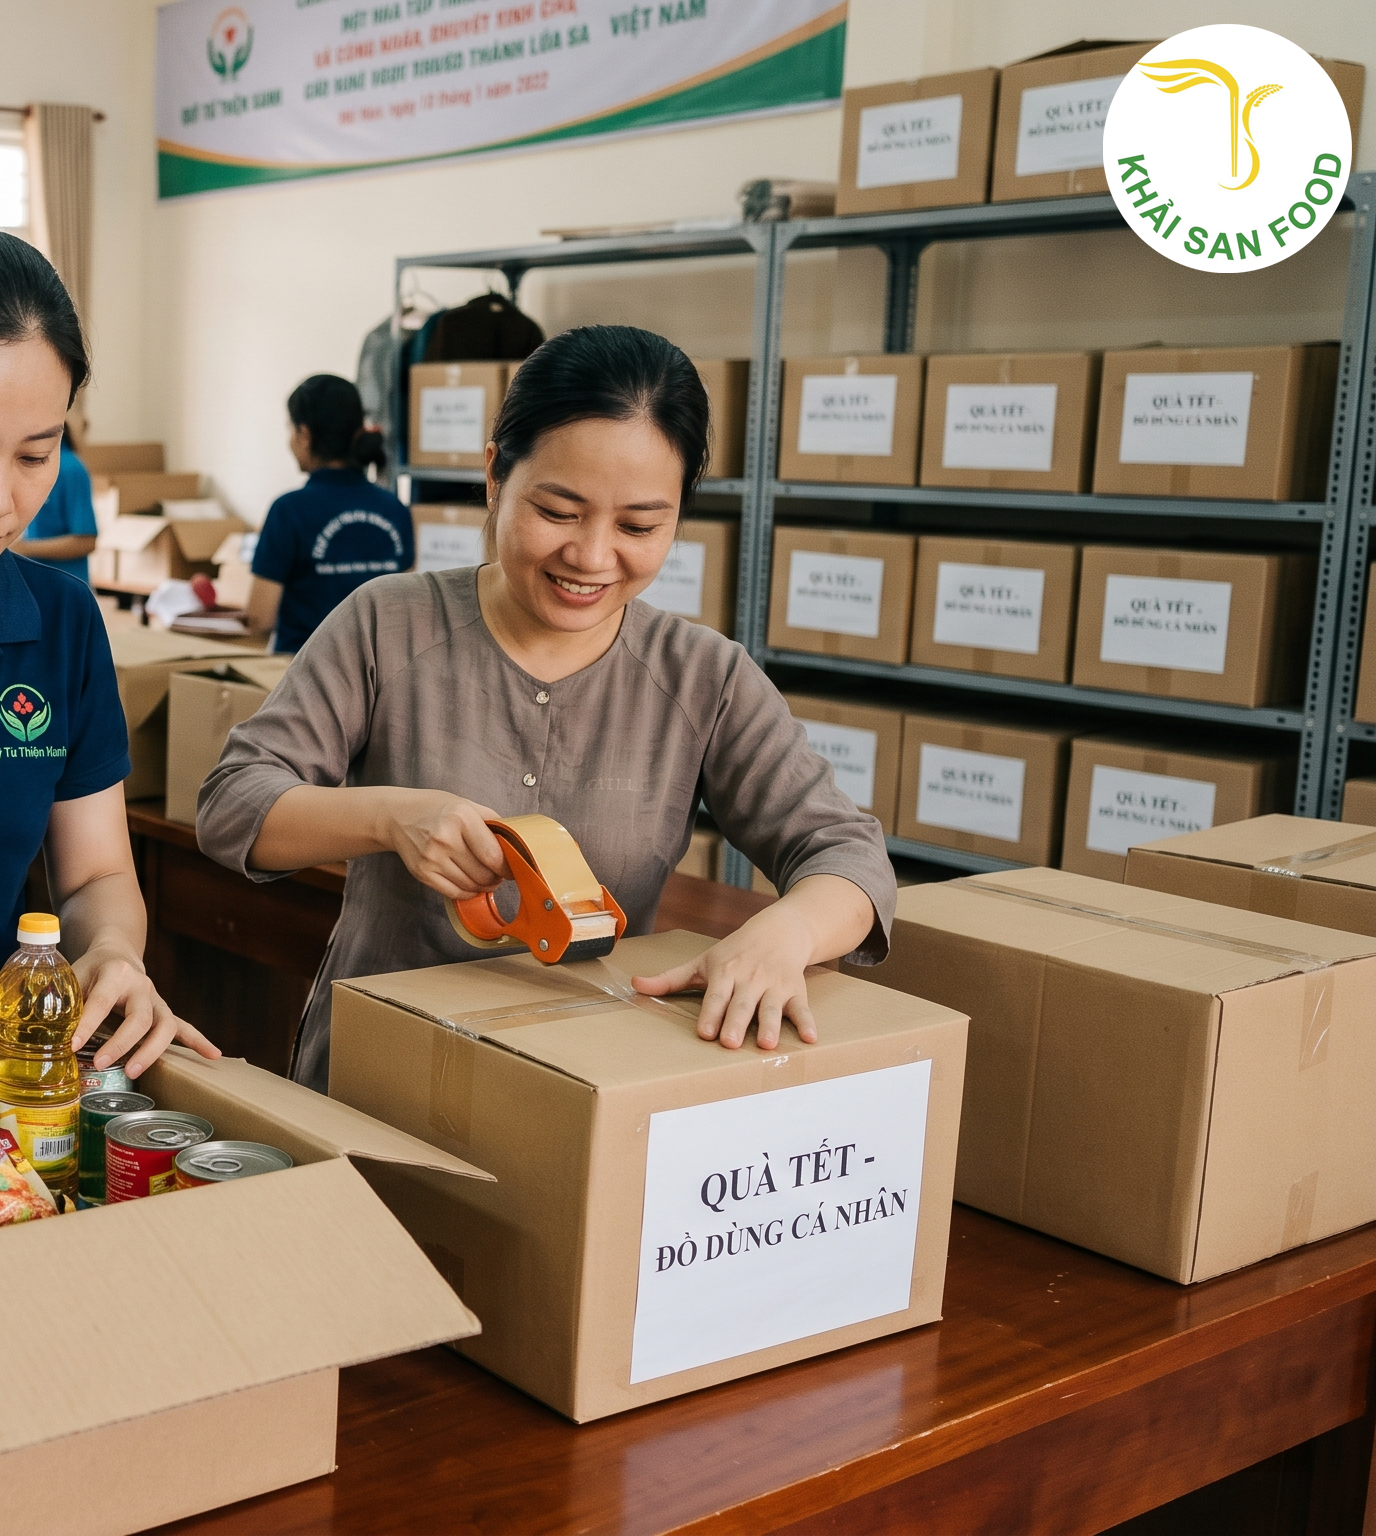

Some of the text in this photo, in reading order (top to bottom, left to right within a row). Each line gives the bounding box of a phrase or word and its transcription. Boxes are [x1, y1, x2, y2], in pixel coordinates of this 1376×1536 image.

[610, 0, 707, 40] VIỆT NAM
[1152, 391, 1182, 410] QUÀ
[1188, 391, 1216, 408] TẾT
[1130, 596, 1161, 613] QUÀ
[1166, 597, 1194, 615] TẾT
[1116, 790, 1146, 808] QUÀ
[1151, 795, 1179, 812] TẾT
[700, 1138, 875, 1213] QUÀ TẾT -
[655, 1186, 908, 1273] ĐỒ DÙNG CÁ NHÂN
